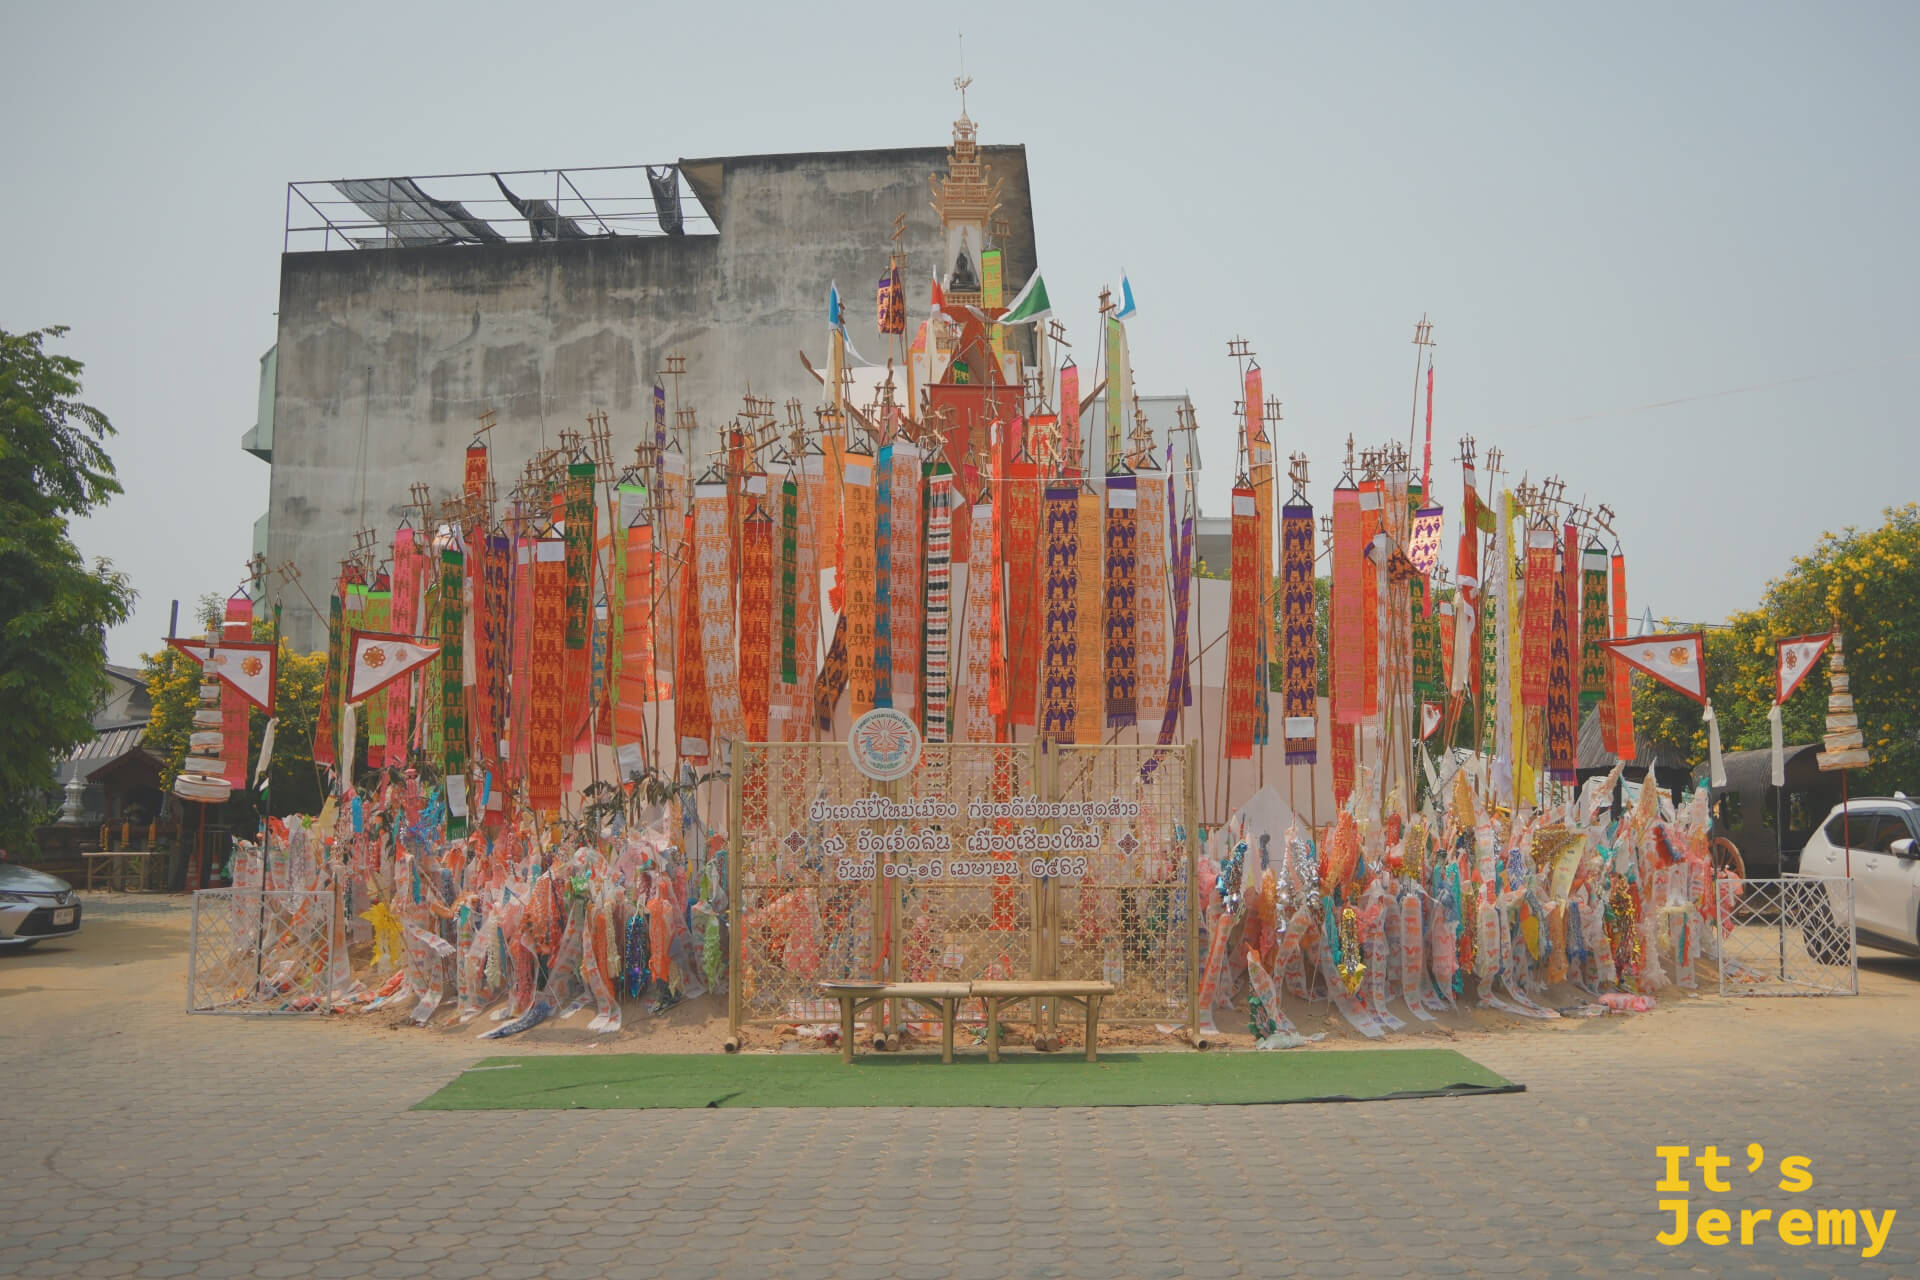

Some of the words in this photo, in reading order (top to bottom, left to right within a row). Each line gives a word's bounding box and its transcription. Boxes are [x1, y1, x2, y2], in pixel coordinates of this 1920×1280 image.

[810, 793, 957, 820] ป๋าเวณีปี๋ใหม่เมือง
[969, 796, 1138, 824] ก่อเจดีย์ทรายสุดส้าว
[824, 836, 845, 854] ณ
[858, 827, 950, 851] วัดเจ็ดลิน
[968, 826, 1100, 851] เมืองเชียงใหม่
[838, 853, 875, 879] วันที่
[884, 859, 942, 877] ๑๐-๑๖
[950, 861, 1018, 876] เมษายน
